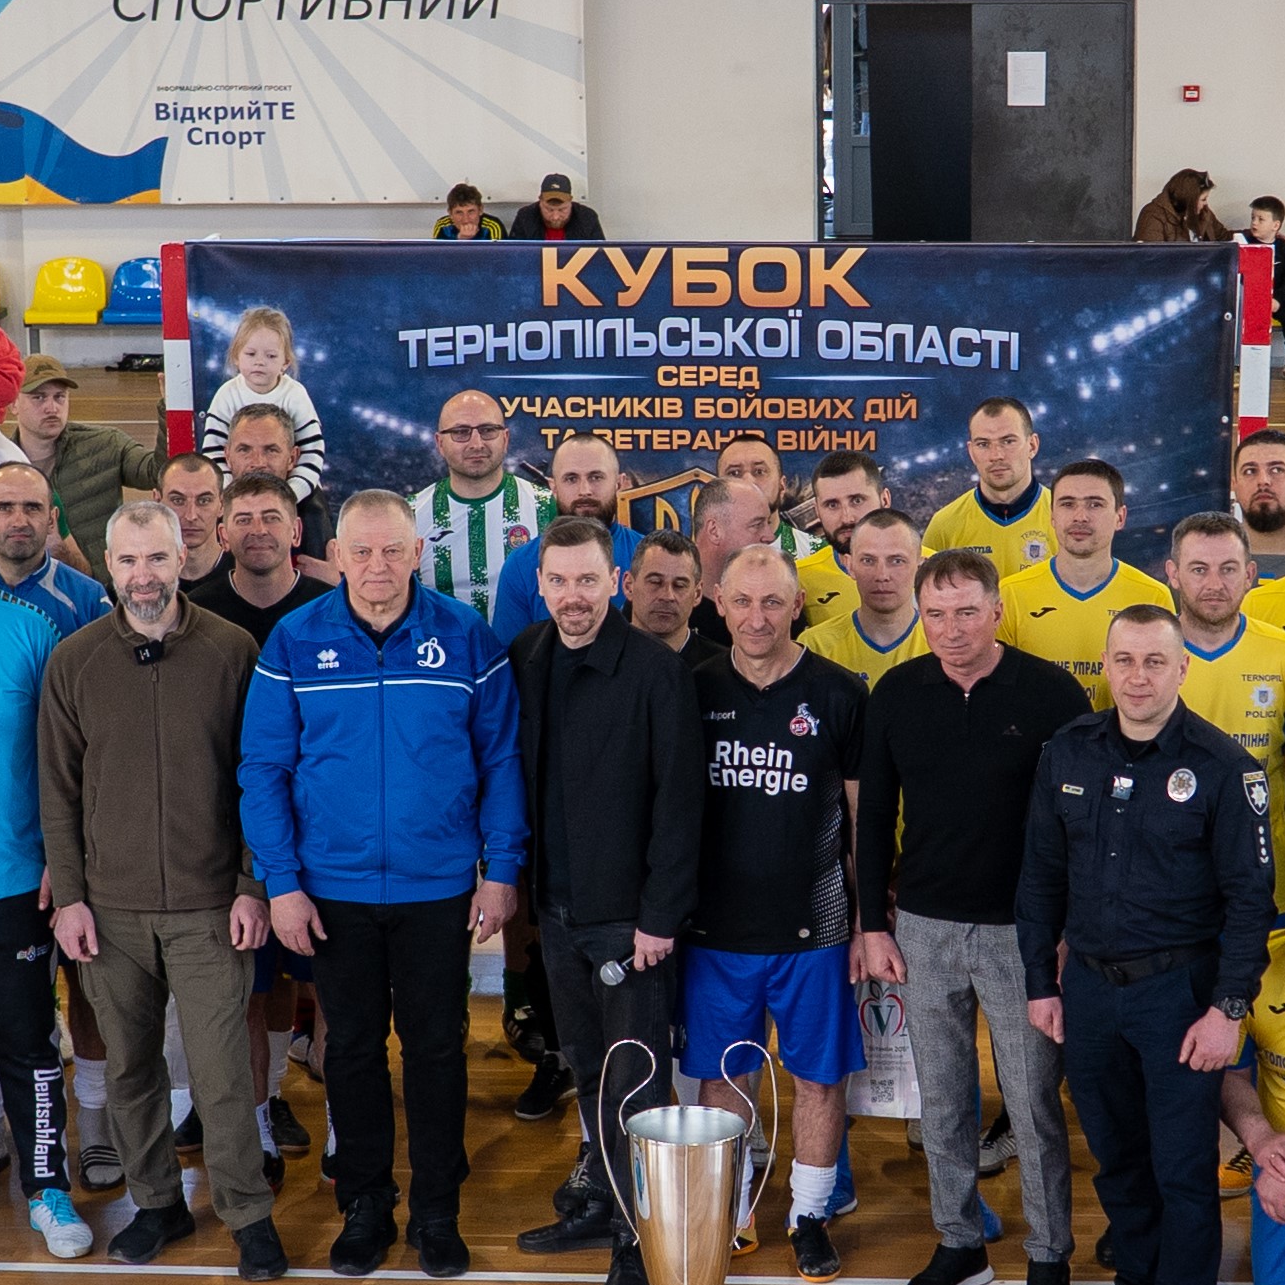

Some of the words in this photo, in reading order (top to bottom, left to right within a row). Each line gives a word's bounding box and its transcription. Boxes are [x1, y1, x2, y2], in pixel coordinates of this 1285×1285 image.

[155, 100, 295, 125] ВідкрийТЕ
[187, 127, 266, 149] Спорт
[541, 246, 872, 309] КУБОК
[398, 309, 803, 370] ТЕРНОПІЛЬСЬКОЇ
[817, 318, 1020, 371] ОБЛАСТІ
[657, 365, 761, 390] СЕРЕД
[500, 396, 684, 420] УЧАСНИКІВ
[694, 391, 855, 420] БОЙОВИХ
[863, 392, 918, 423] ДІЙ
[777, 425, 877, 452] ВІЙНИ
[1241, 674, 1283, 682] TERNOPIL
[715, 740, 793, 770] Rhein
[708, 762, 808, 796] Energie
[33, 1066, 62, 1178] Deutschland
